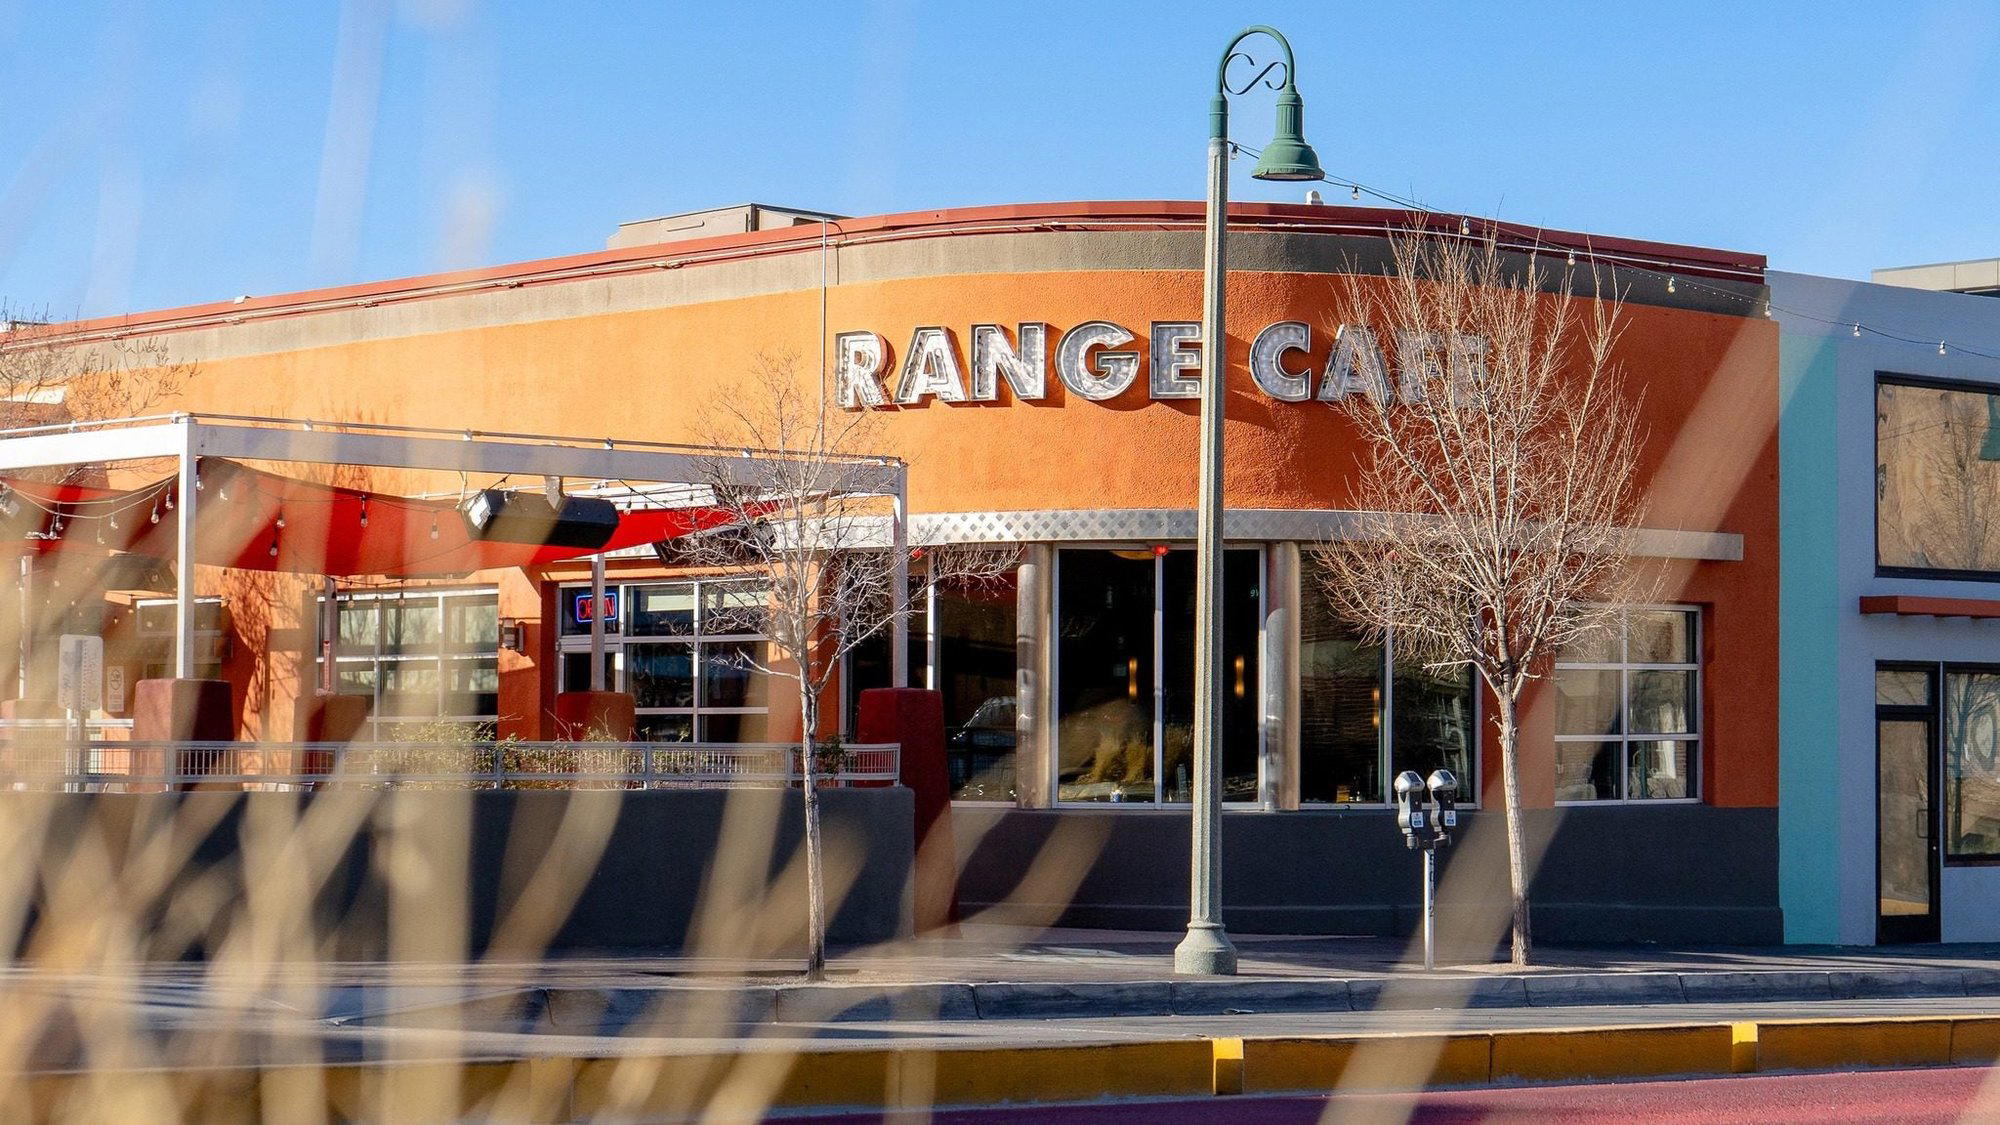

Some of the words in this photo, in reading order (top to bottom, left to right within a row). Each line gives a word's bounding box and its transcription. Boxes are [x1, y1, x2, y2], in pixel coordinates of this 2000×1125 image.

[835, 321, 1201, 408] RANGE
[1249, 321, 1491, 407] CAFE
[579, 597, 615, 618] OPN
